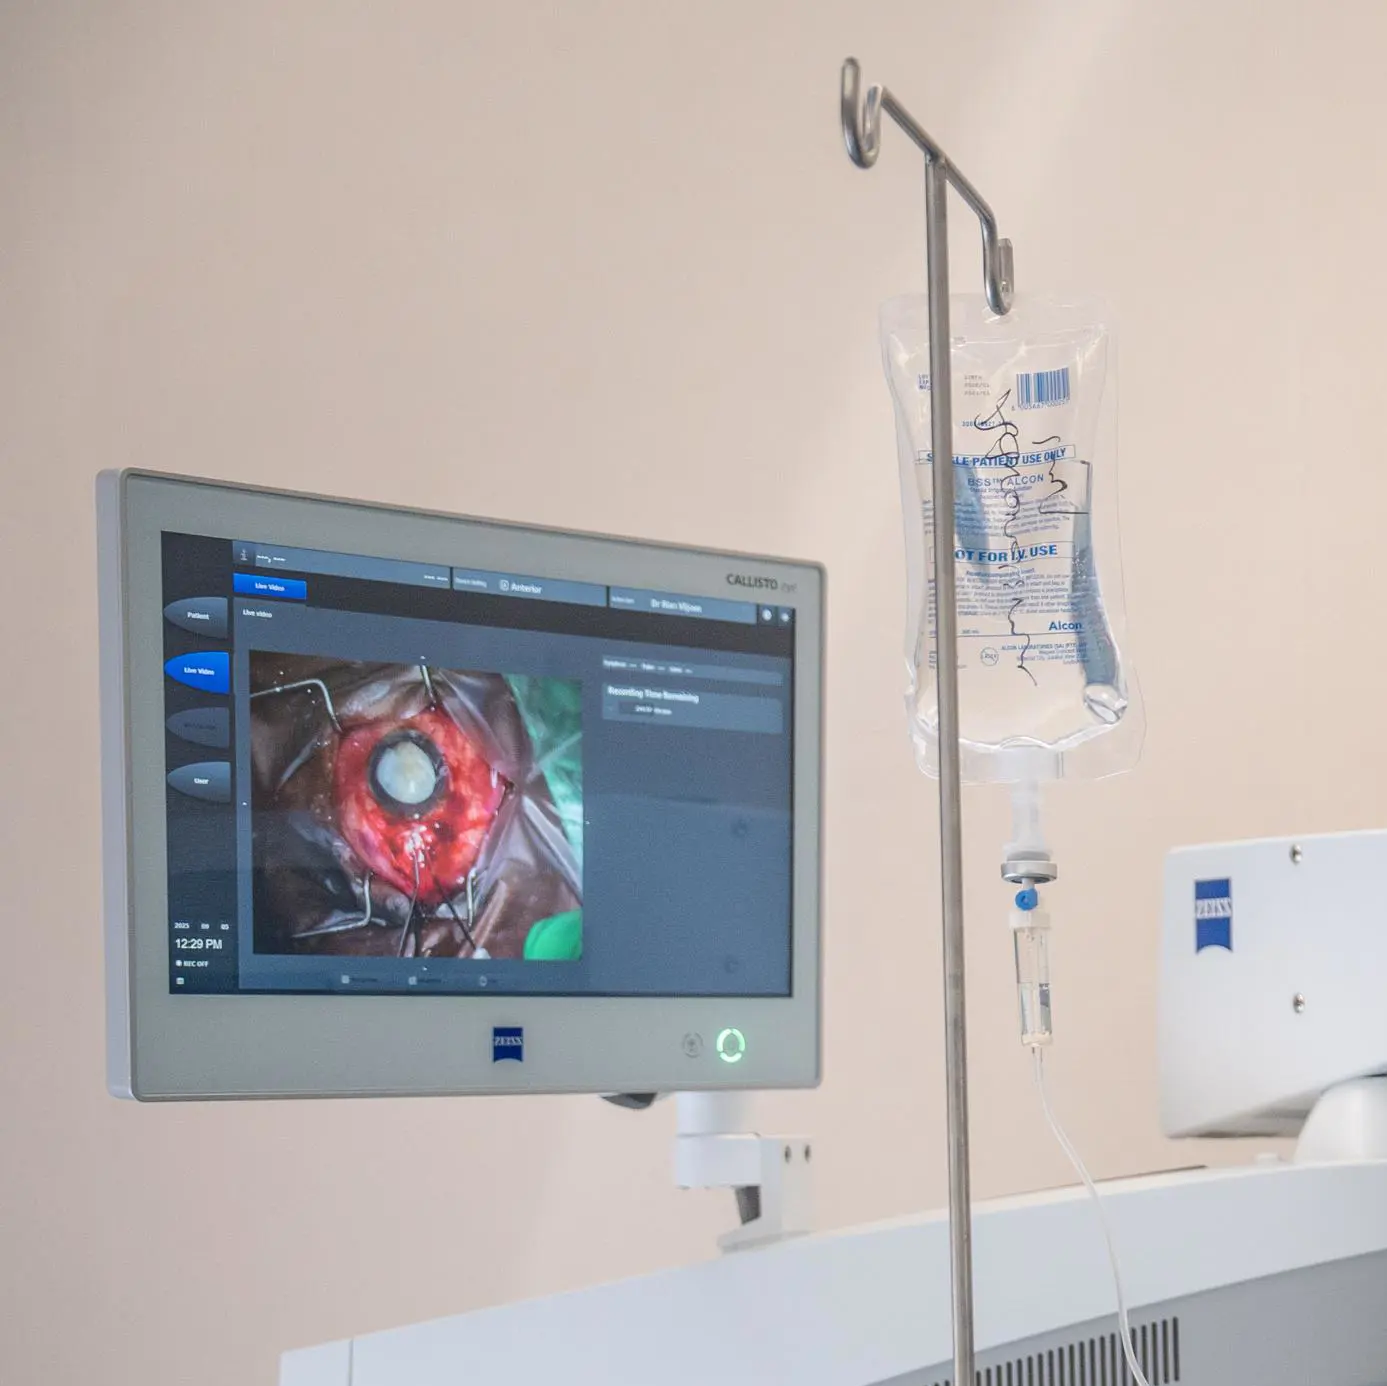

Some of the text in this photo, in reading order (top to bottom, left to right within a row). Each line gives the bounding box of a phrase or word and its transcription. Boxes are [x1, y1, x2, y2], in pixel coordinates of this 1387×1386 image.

[972, 457, 1018, 466] PATIENT
[1022, 454, 1041, 464] USE
[1044, 448, 1066, 460] ONLY
[1007, 474, 1044, 486] ALCON
[955, 550, 974, 562] OT
[978, 550, 1007, 562] FOR
[1030, 544, 1058, 556] USE
[726, 573, 778, 590] CALLISTO
[1048, 621, 1083, 631] Alcon
[175, 938, 223, 950] 12:29 PM
